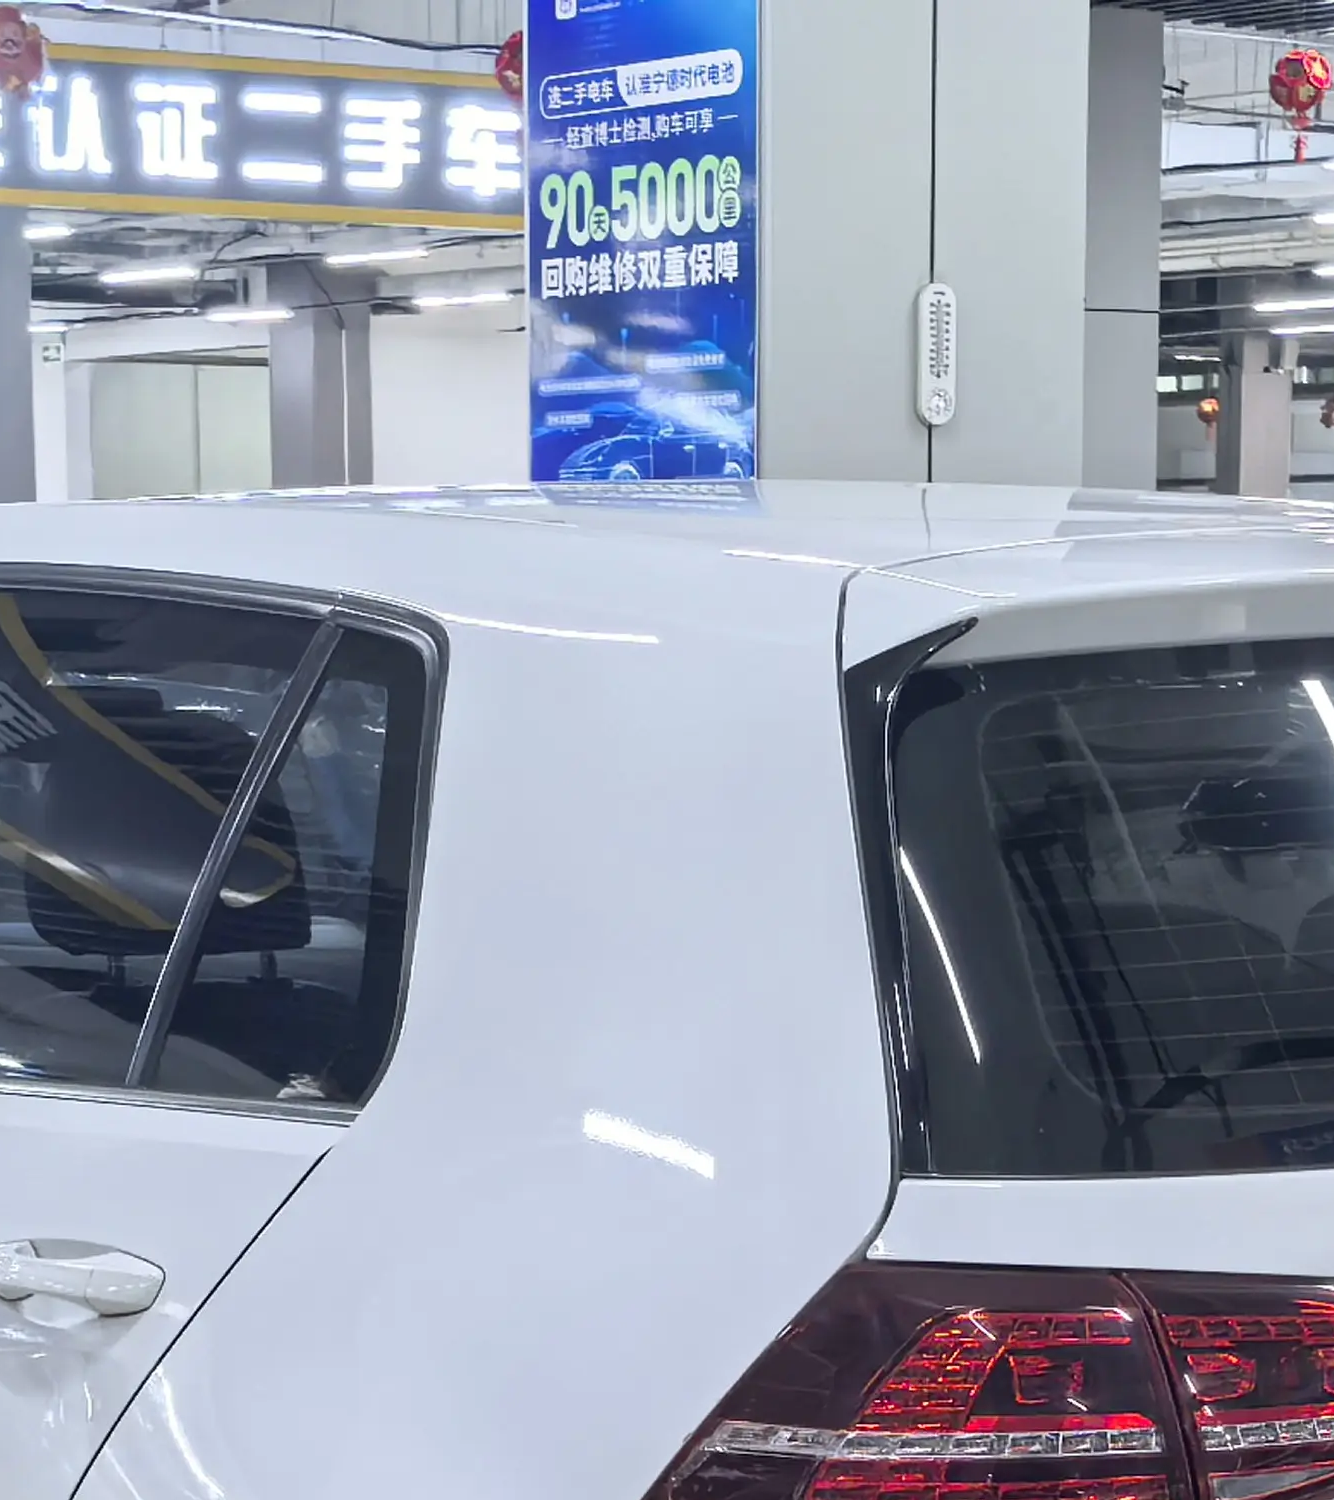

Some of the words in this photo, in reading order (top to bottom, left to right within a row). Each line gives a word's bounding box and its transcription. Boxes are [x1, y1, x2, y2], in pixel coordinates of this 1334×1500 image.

[541, 240, 740, 300] 回购维修双重保障
